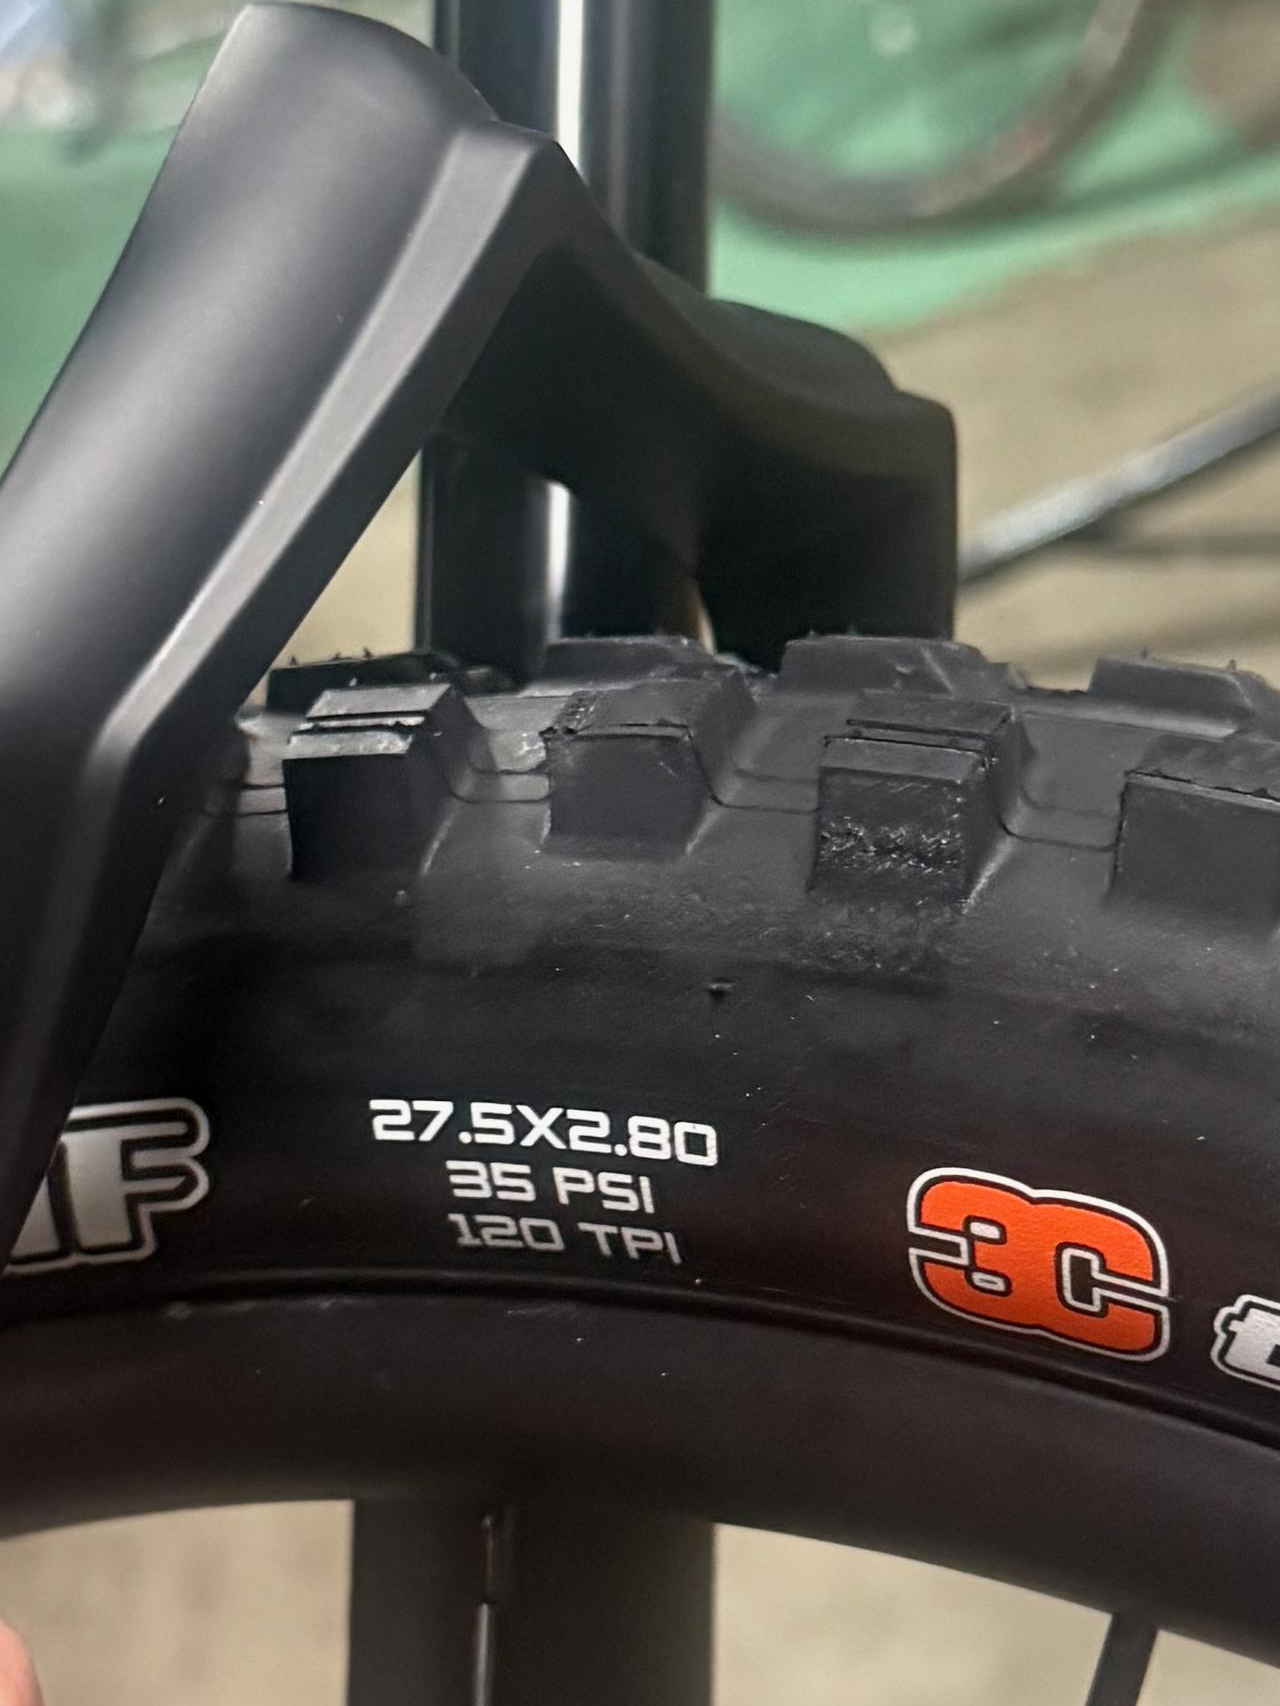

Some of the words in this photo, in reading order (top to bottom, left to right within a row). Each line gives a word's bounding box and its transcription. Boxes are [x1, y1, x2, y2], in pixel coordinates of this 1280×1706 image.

[368, 1099, 719, 1166] 27.5X2.80
[446, 1160, 538, 1203] 35
[554, 1166, 655, 1214] PSI
[447, 1212, 565, 1252] 120
[578, 1222, 683, 1265] TPI
[907, 1167, 1170, 1362] 3C
